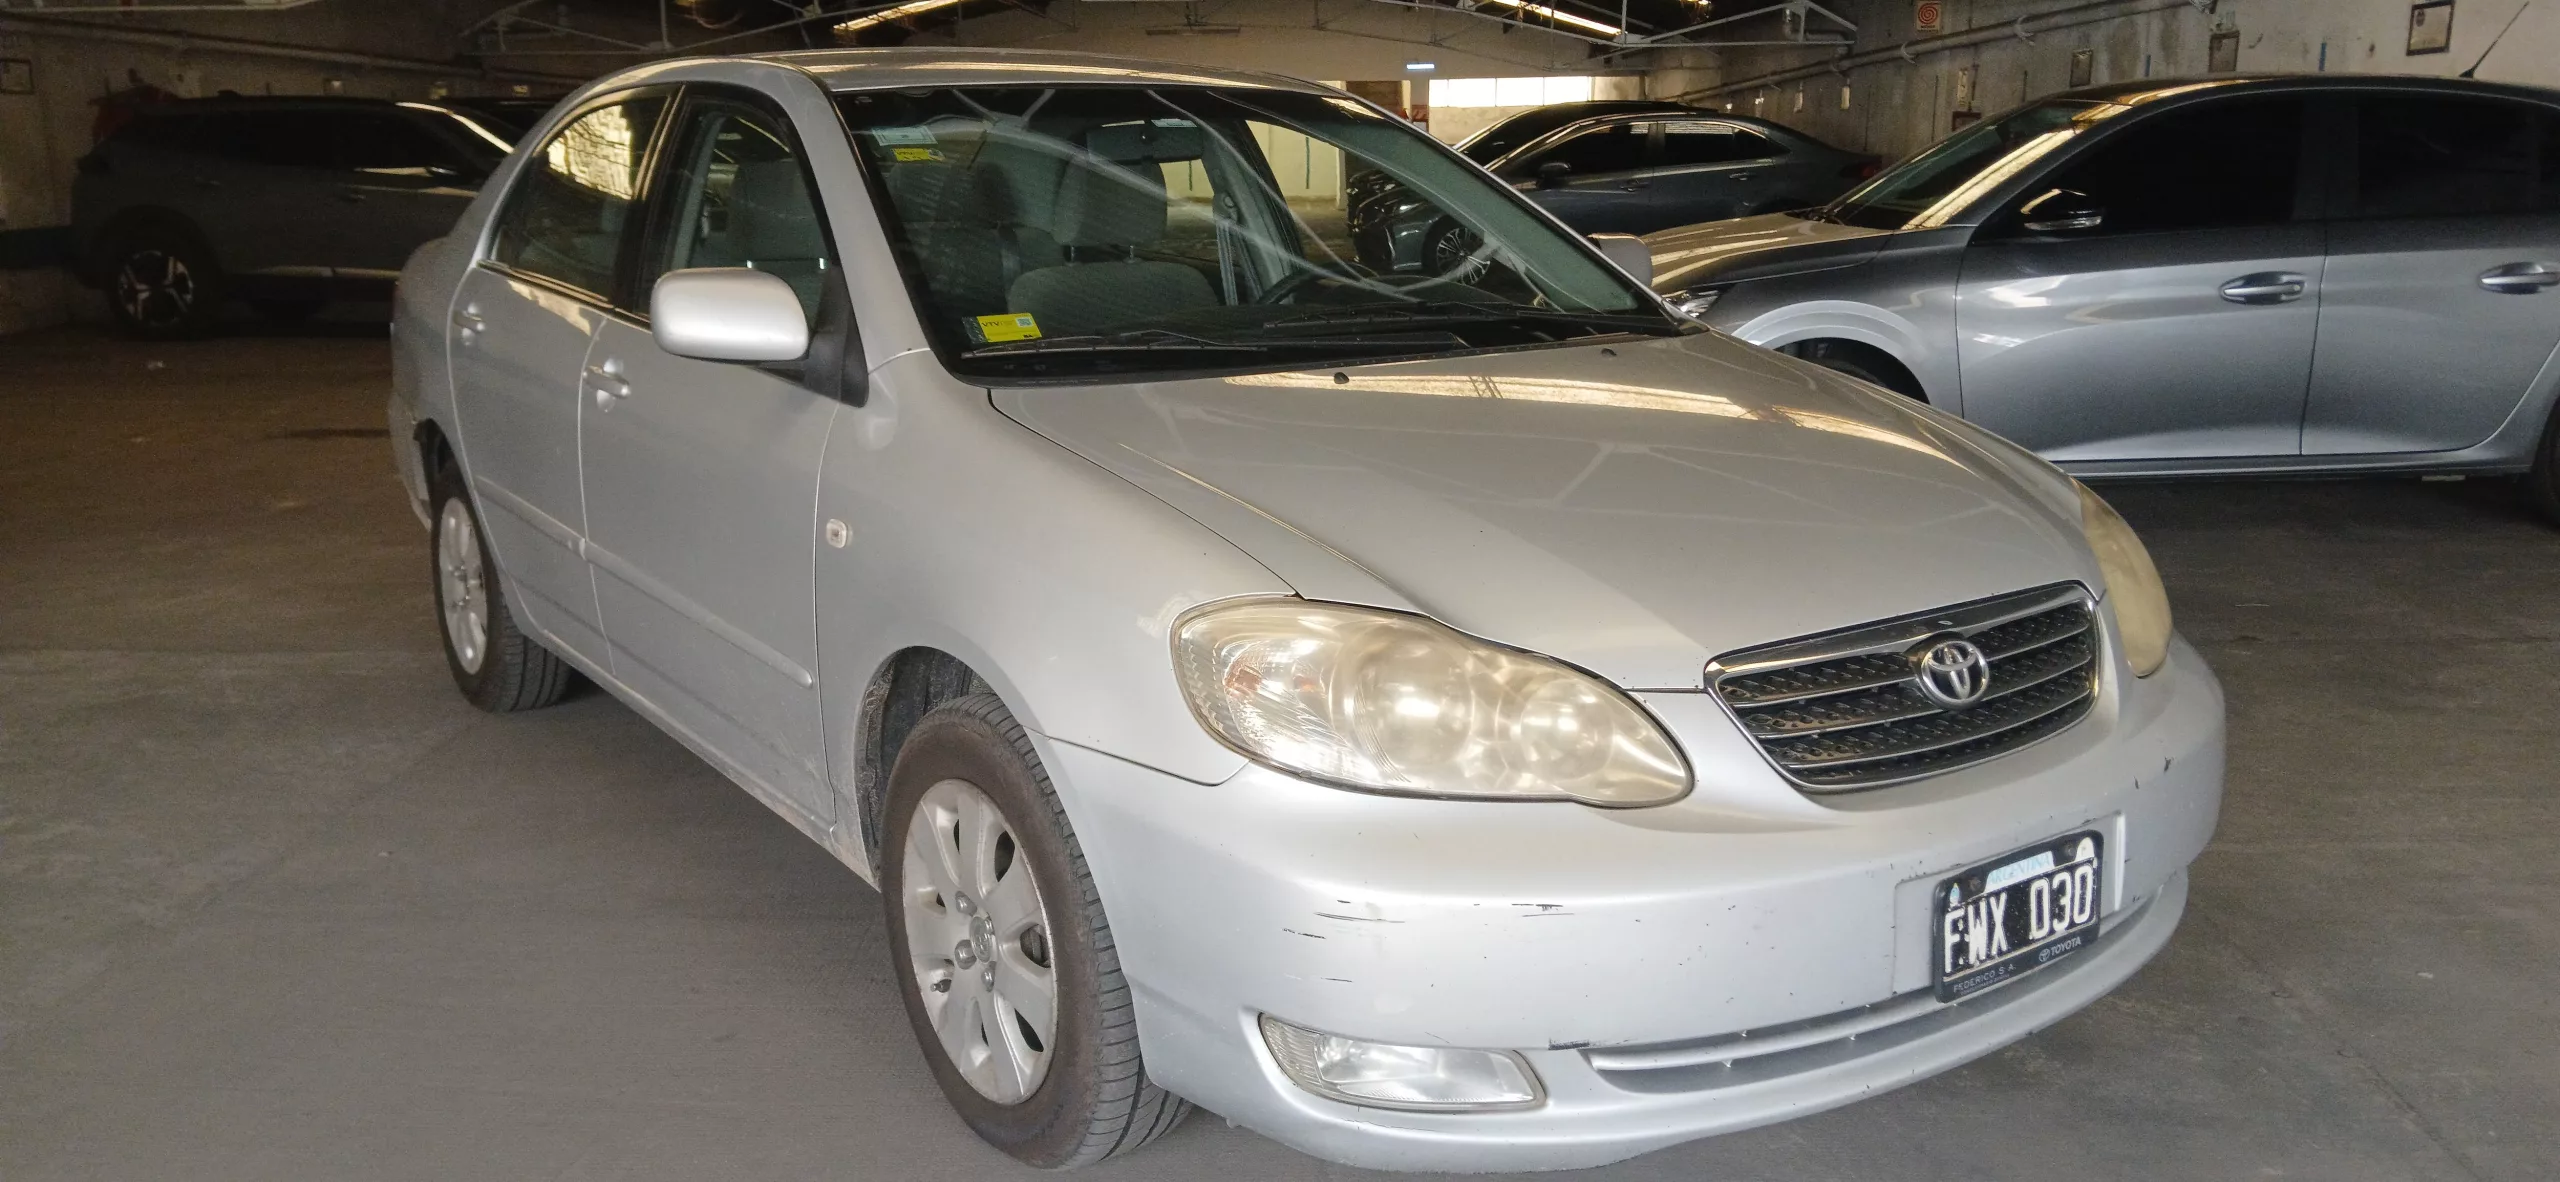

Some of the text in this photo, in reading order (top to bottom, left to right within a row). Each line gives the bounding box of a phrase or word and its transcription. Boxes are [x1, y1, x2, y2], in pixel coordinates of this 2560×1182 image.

[1944, 864, 2094, 974] FWX 030
[2050, 937, 2082, 956] TOYOTA
[1953, 970, 1996, 993] FEDERICO
